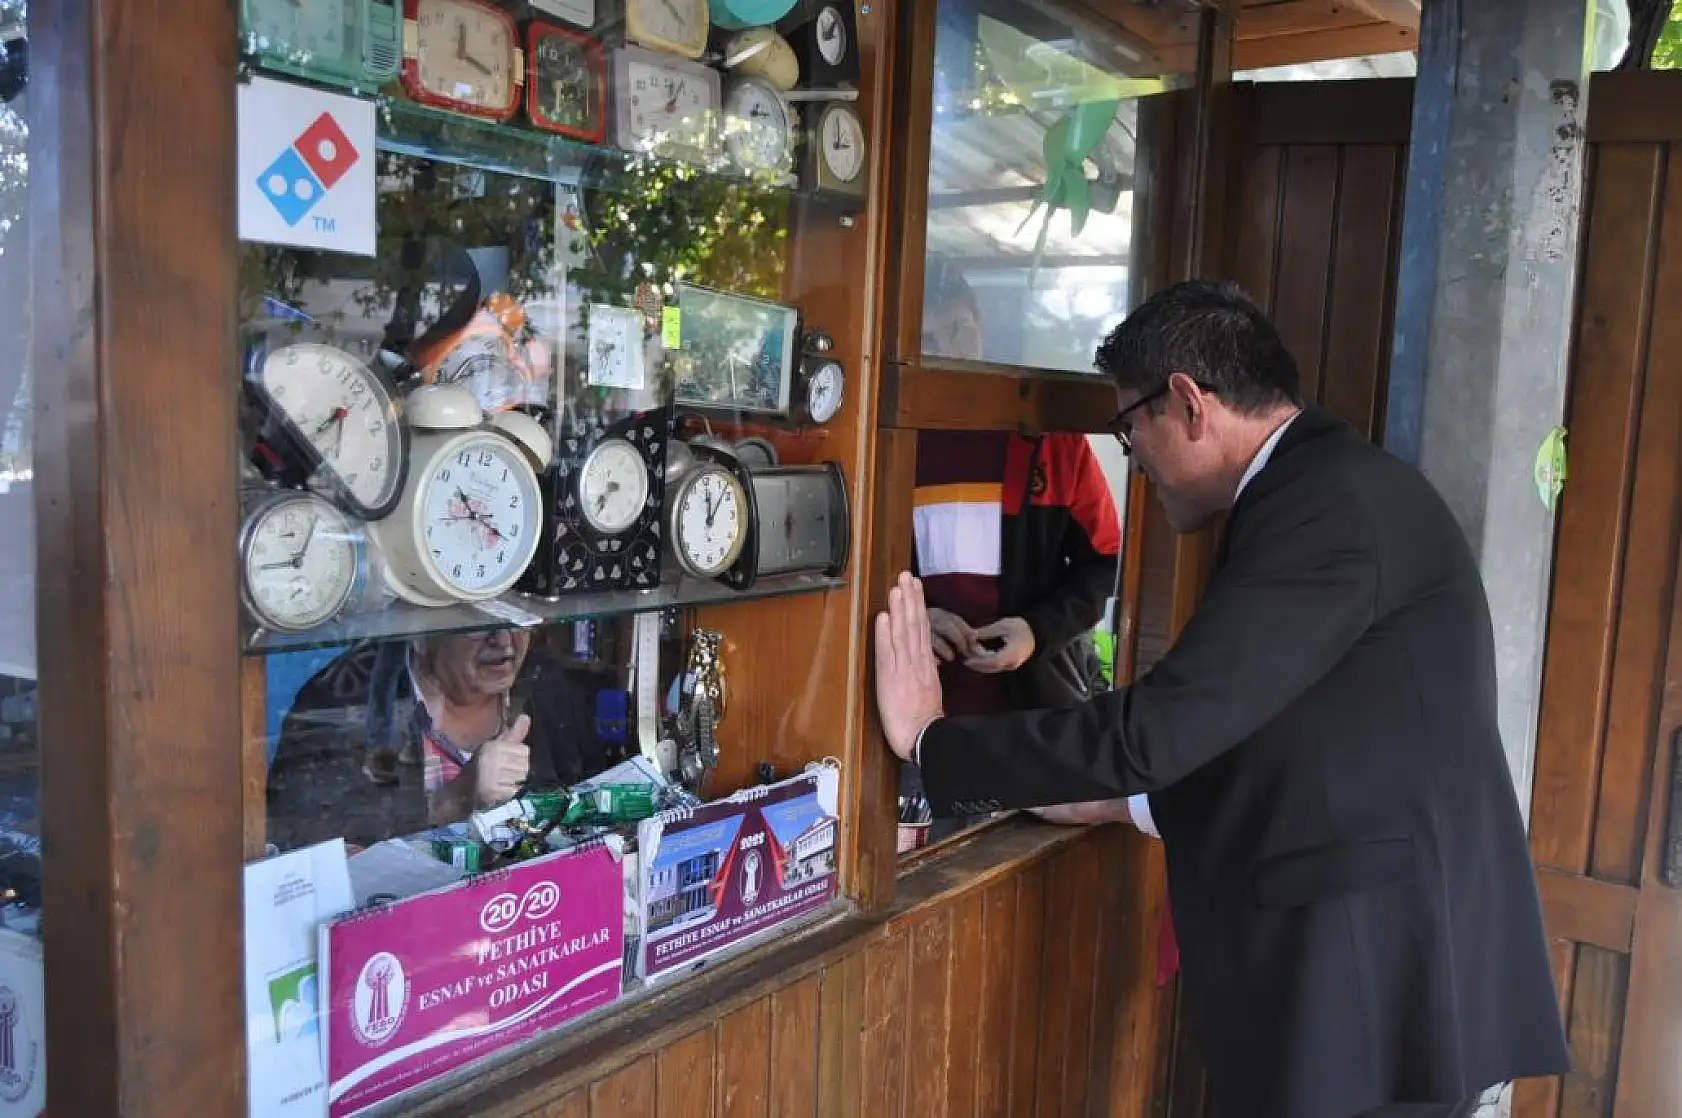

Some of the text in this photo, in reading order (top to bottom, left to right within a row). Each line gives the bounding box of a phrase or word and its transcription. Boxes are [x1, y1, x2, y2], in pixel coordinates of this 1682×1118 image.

[312, 215, 336, 232] TM
[477, 920, 562, 966] FETHİYE
[418, 928, 611, 1010] ESNAF ve SANATKARLAR
[489, 971, 549, 1009] ODASI
